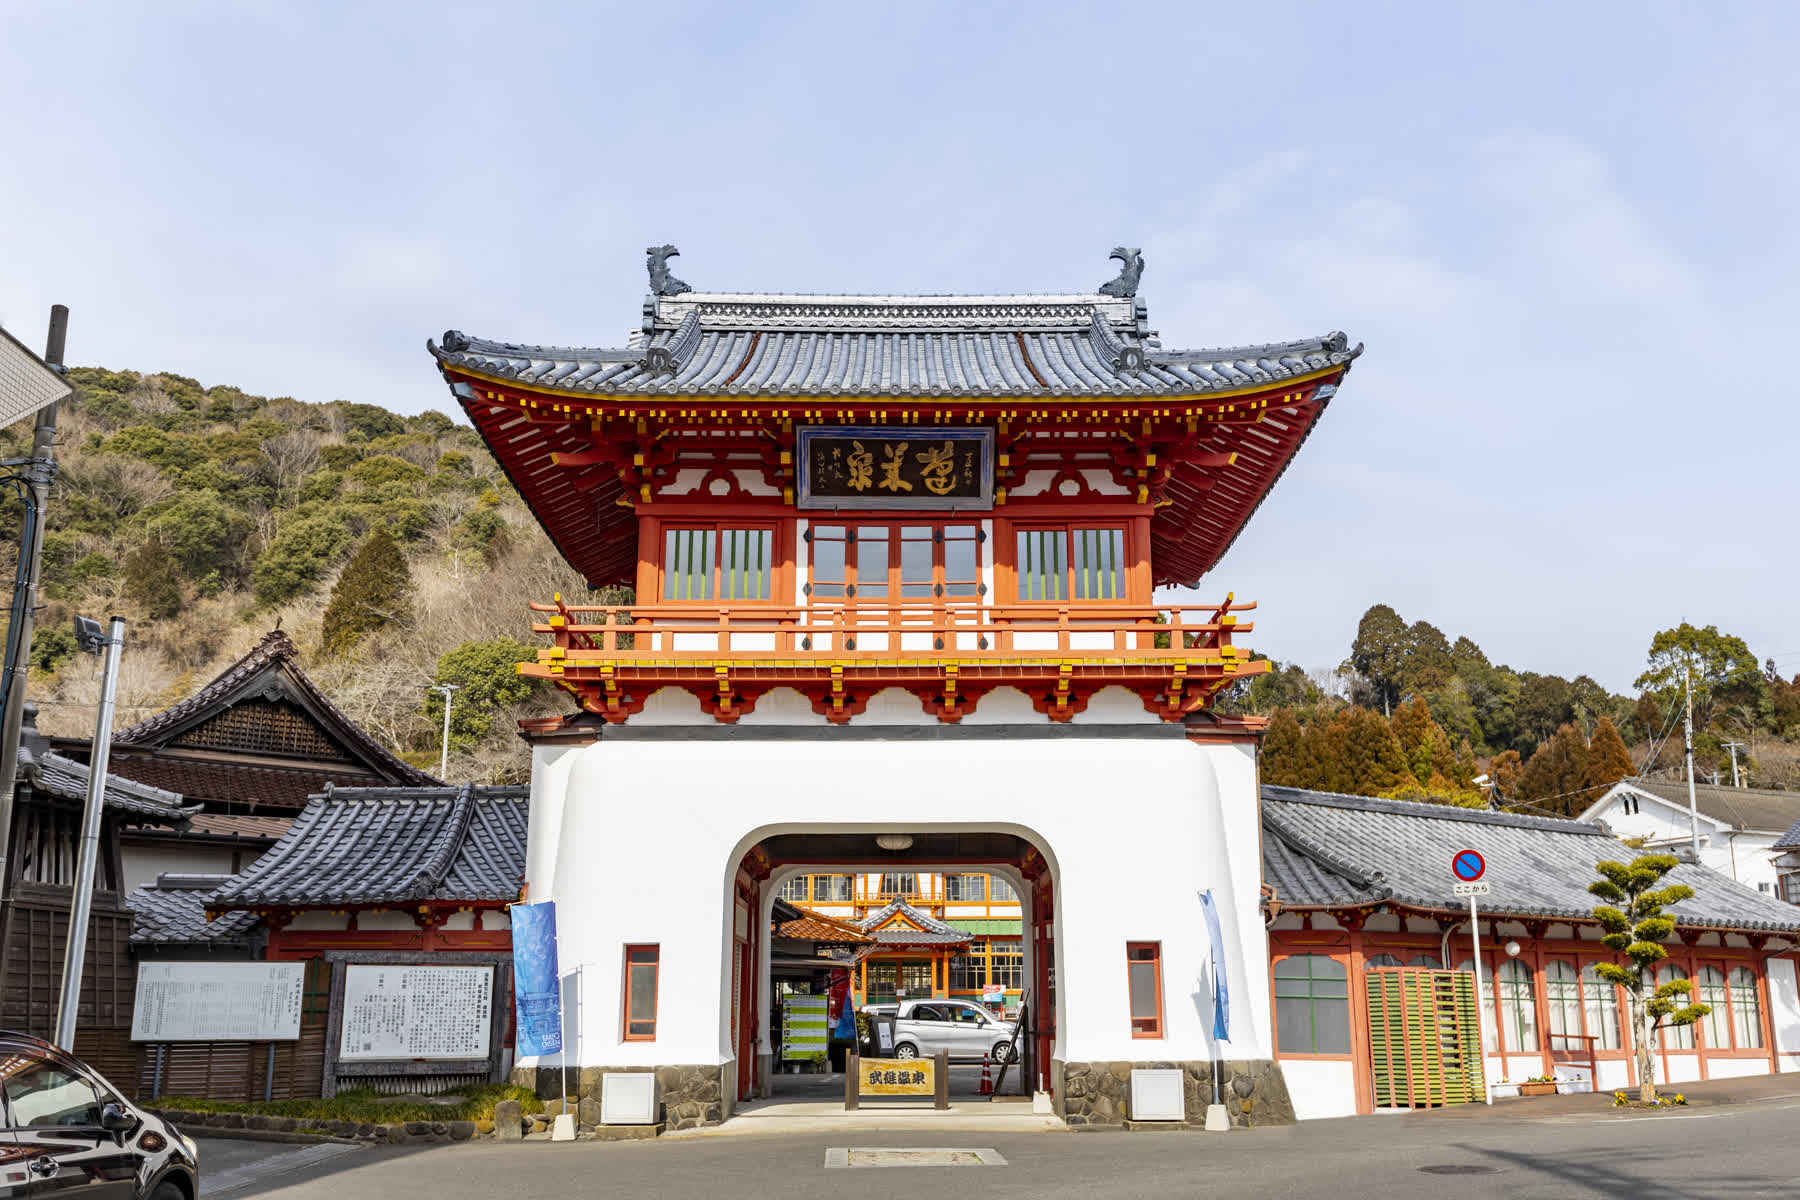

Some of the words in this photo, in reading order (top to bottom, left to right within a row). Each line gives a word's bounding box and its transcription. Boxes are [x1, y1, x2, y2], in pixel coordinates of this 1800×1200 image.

[1455, 884, 1488, 893] ここから
[869, 1070, 926, 1085] 武雄温泉
